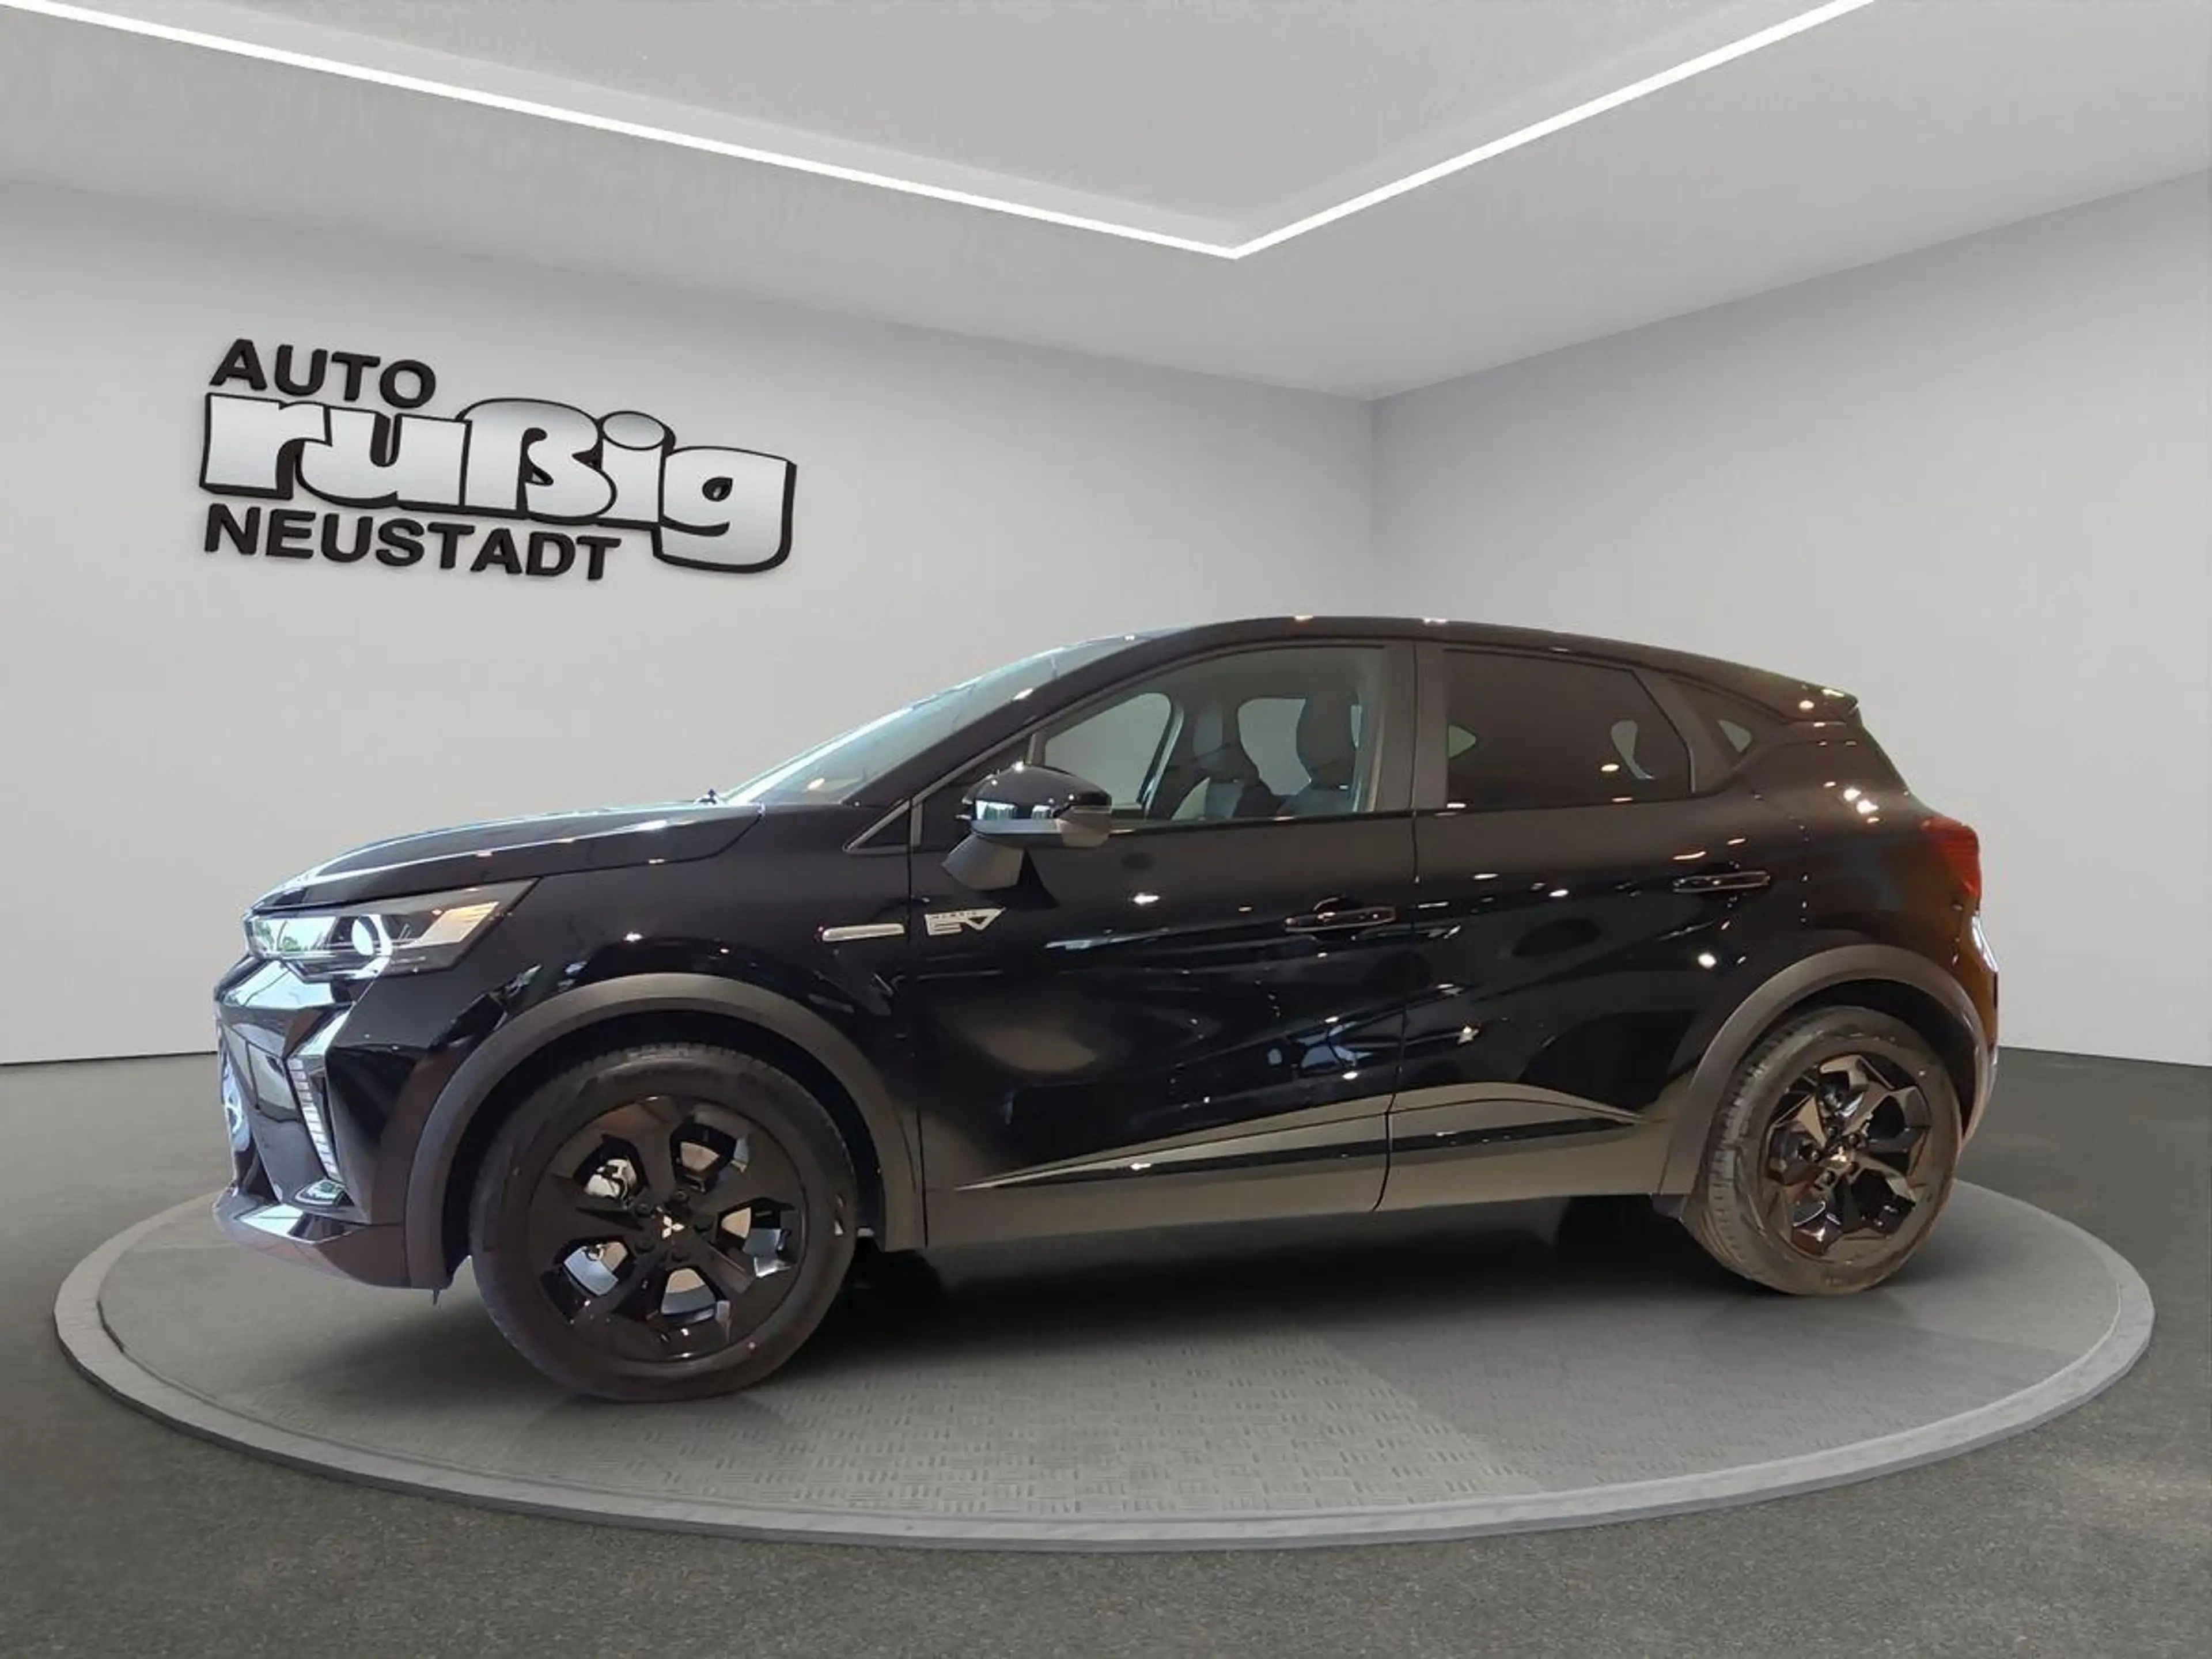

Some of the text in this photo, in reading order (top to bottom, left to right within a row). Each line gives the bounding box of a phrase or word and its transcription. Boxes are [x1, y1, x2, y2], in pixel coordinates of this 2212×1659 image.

[210, 339, 436, 409] AUTO
[199, 393, 797, 574] rußig
[204, 503, 622, 581] NEUSTADT
